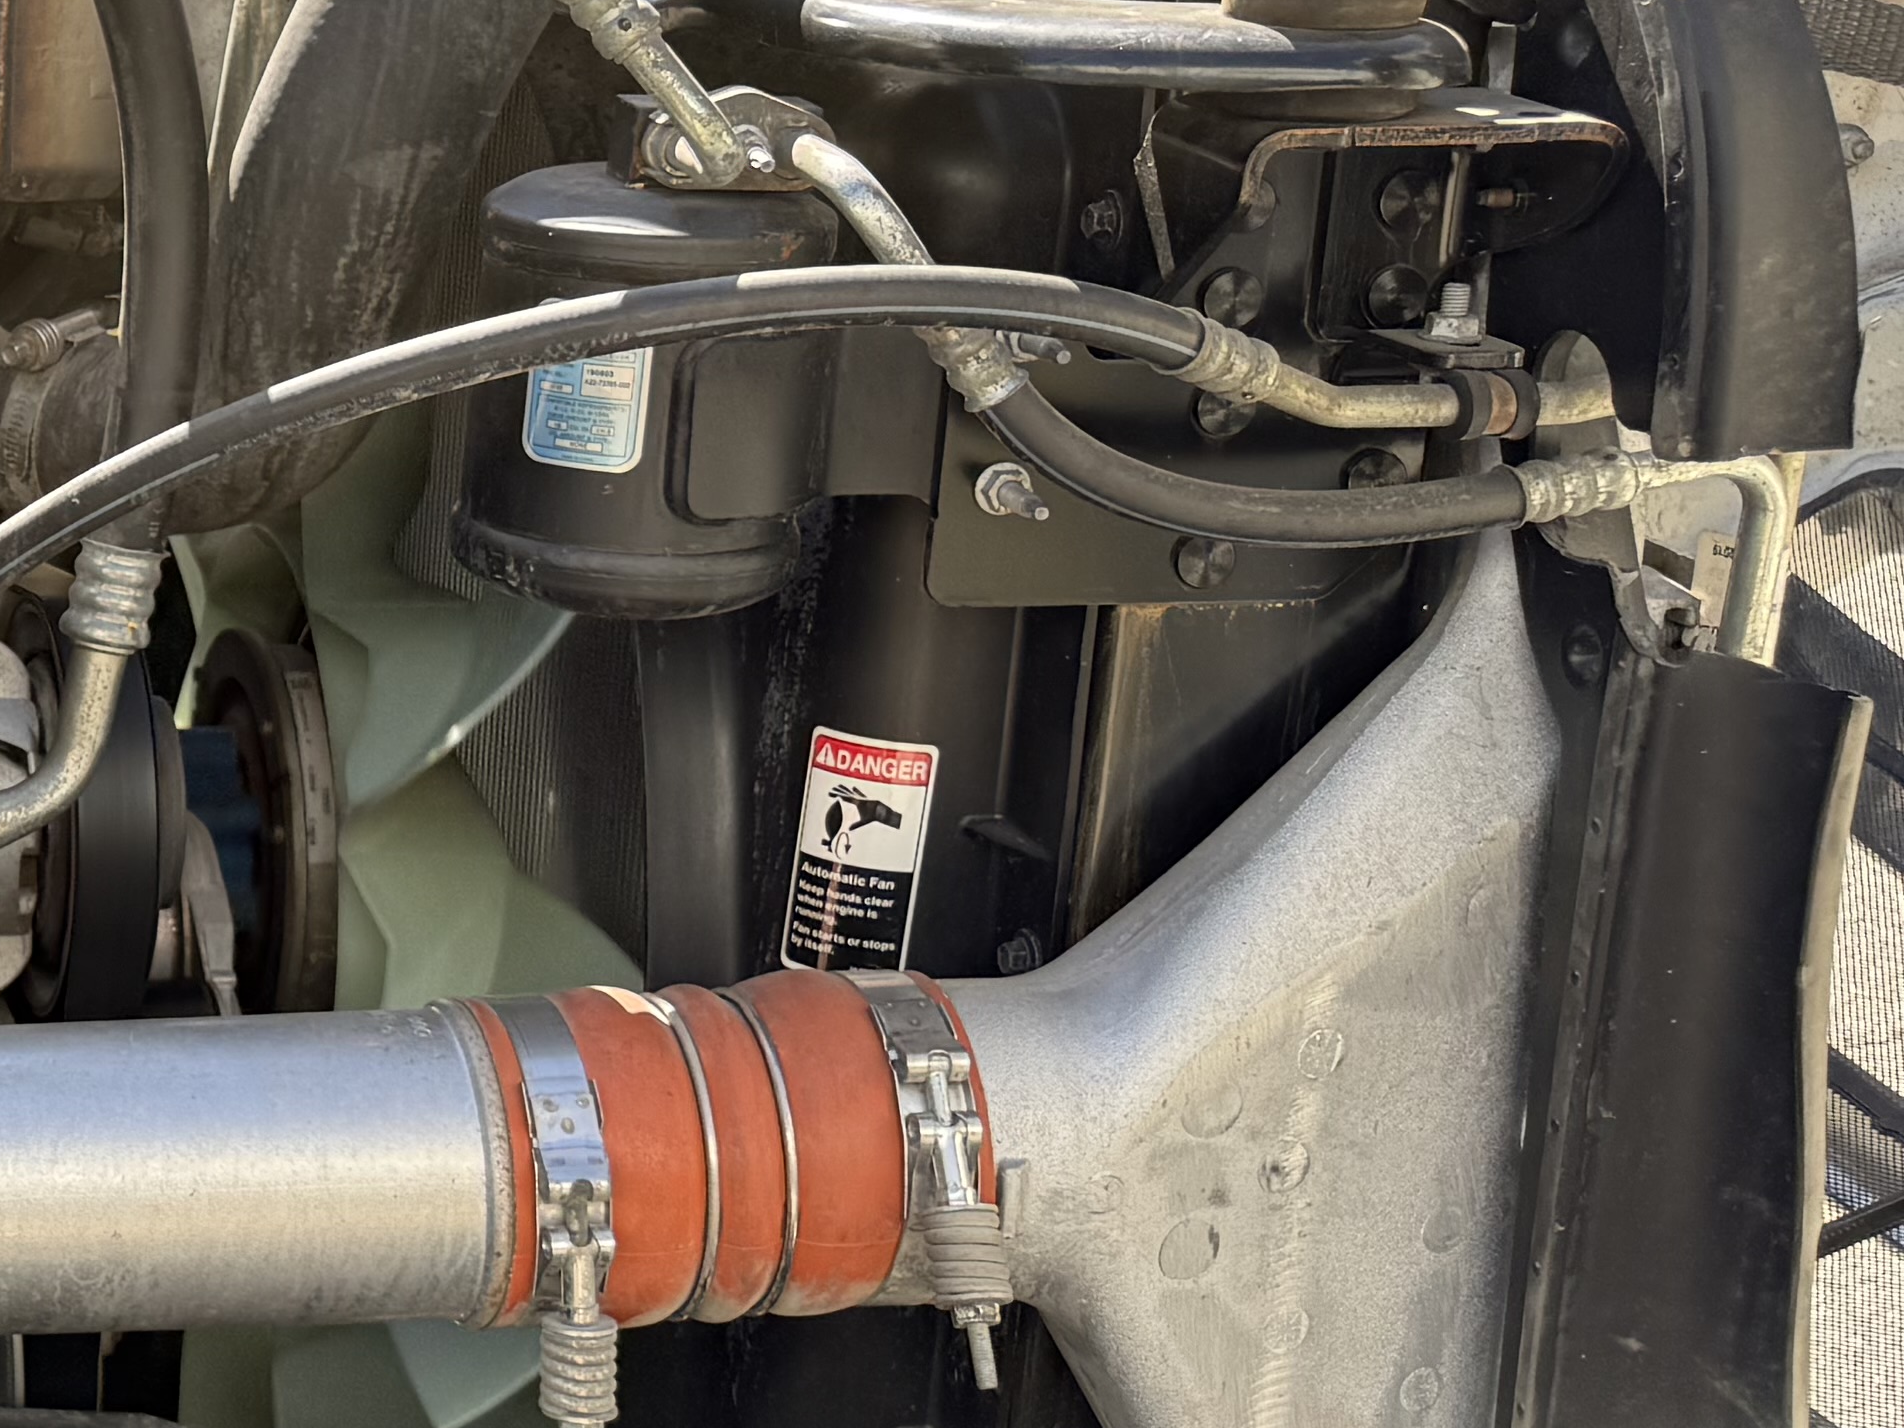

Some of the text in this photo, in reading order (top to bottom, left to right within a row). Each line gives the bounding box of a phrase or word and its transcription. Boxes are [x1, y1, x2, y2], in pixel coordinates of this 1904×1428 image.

[836, 749, 928, 781] DANGER
[801, 861, 896, 891] Automatic Fan
[797, 893, 878, 919] when engine is
[799, 878, 895, 908] Keep hands clear
[791, 933, 835, 955] by itself.
[793, 920, 896, 952] Fan starts or stops
